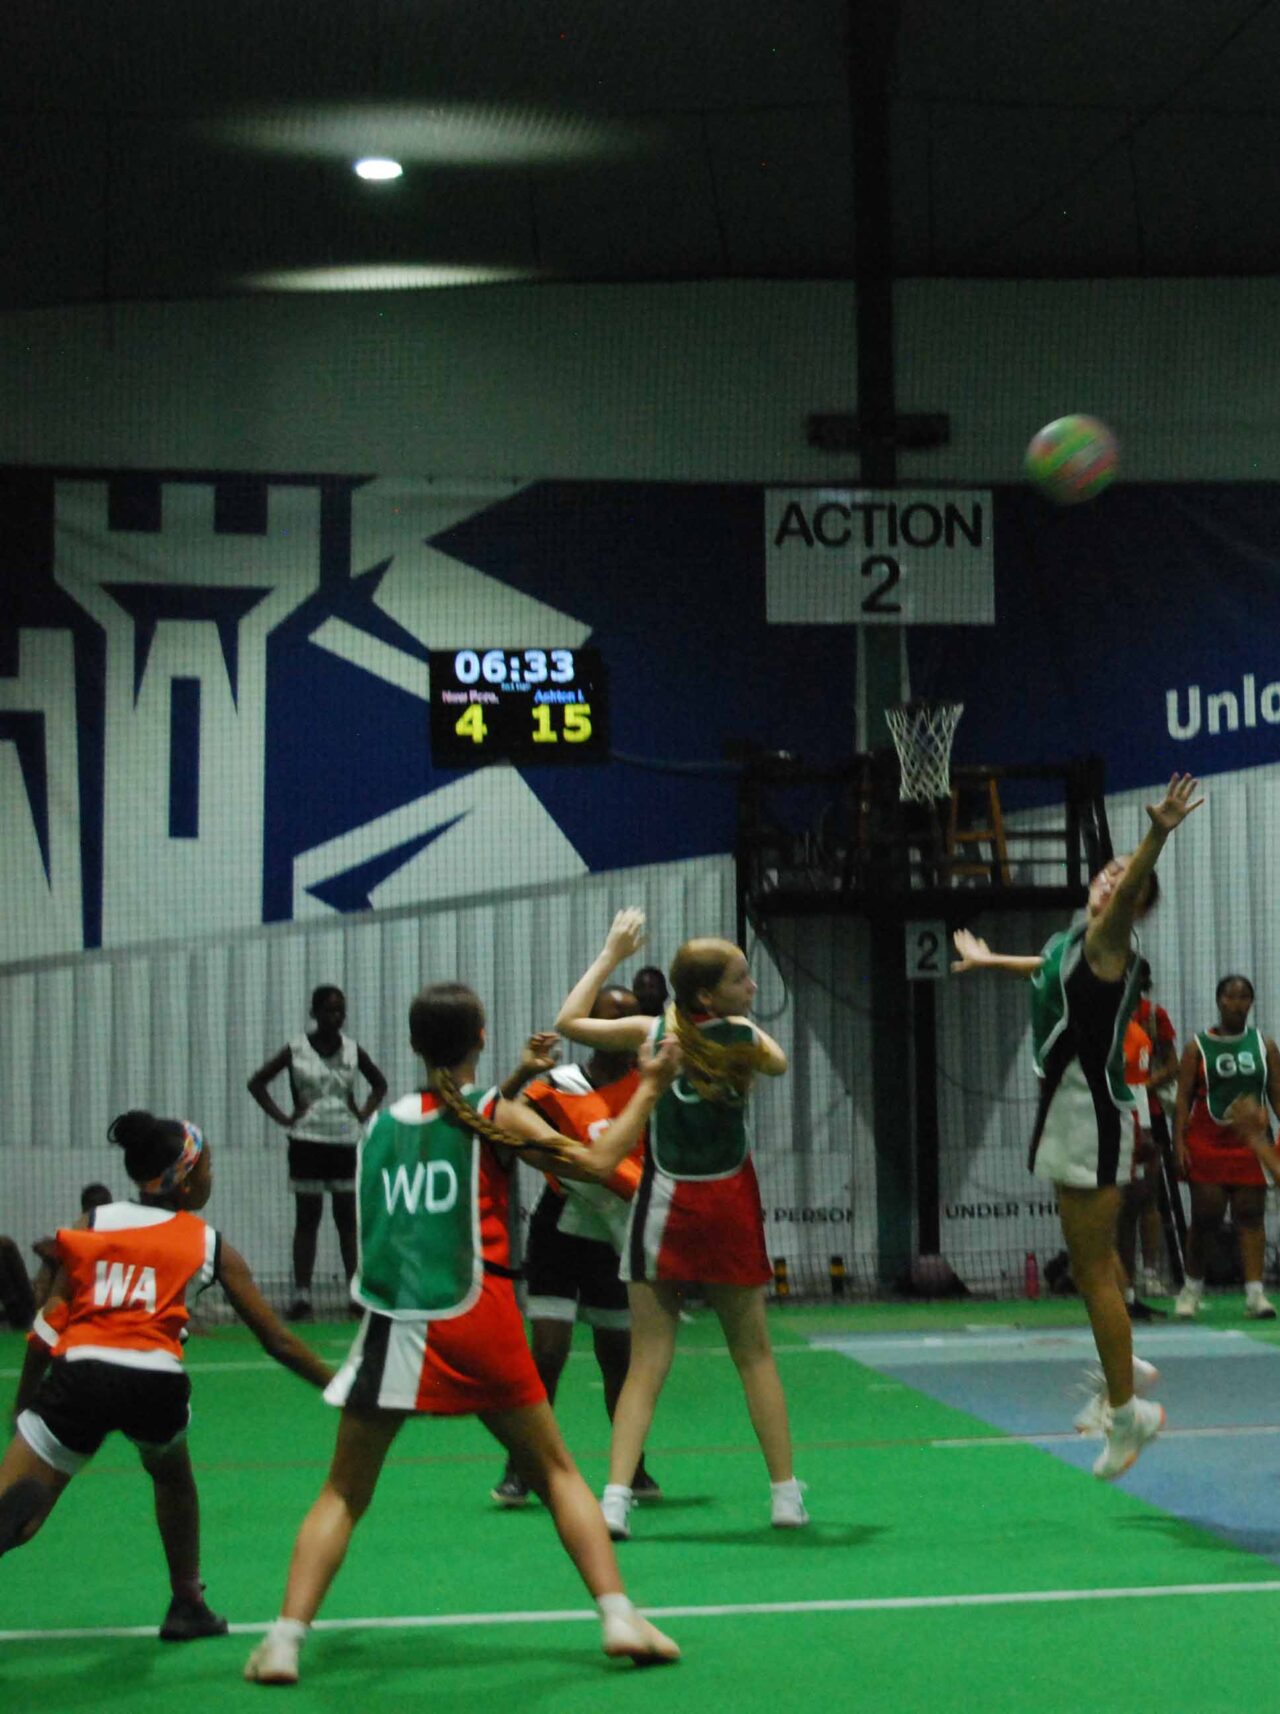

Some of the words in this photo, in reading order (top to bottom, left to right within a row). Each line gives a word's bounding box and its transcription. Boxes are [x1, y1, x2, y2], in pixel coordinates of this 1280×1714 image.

[774, 501, 984, 548] ACTION
[860, 554, 903, 613] 2
[454, 649, 575, 685] 06:33
[455, 703, 488, 744] 4
[531, 703, 593, 743] 15
[917, 930, 938, 971] 2
[1215, 1050, 1257, 1079] GS
[380, 1158, 460, 1215] WD
[945, 1203, 1019, 1219] UNDER
[92, 1259, 157, 1315] WA
